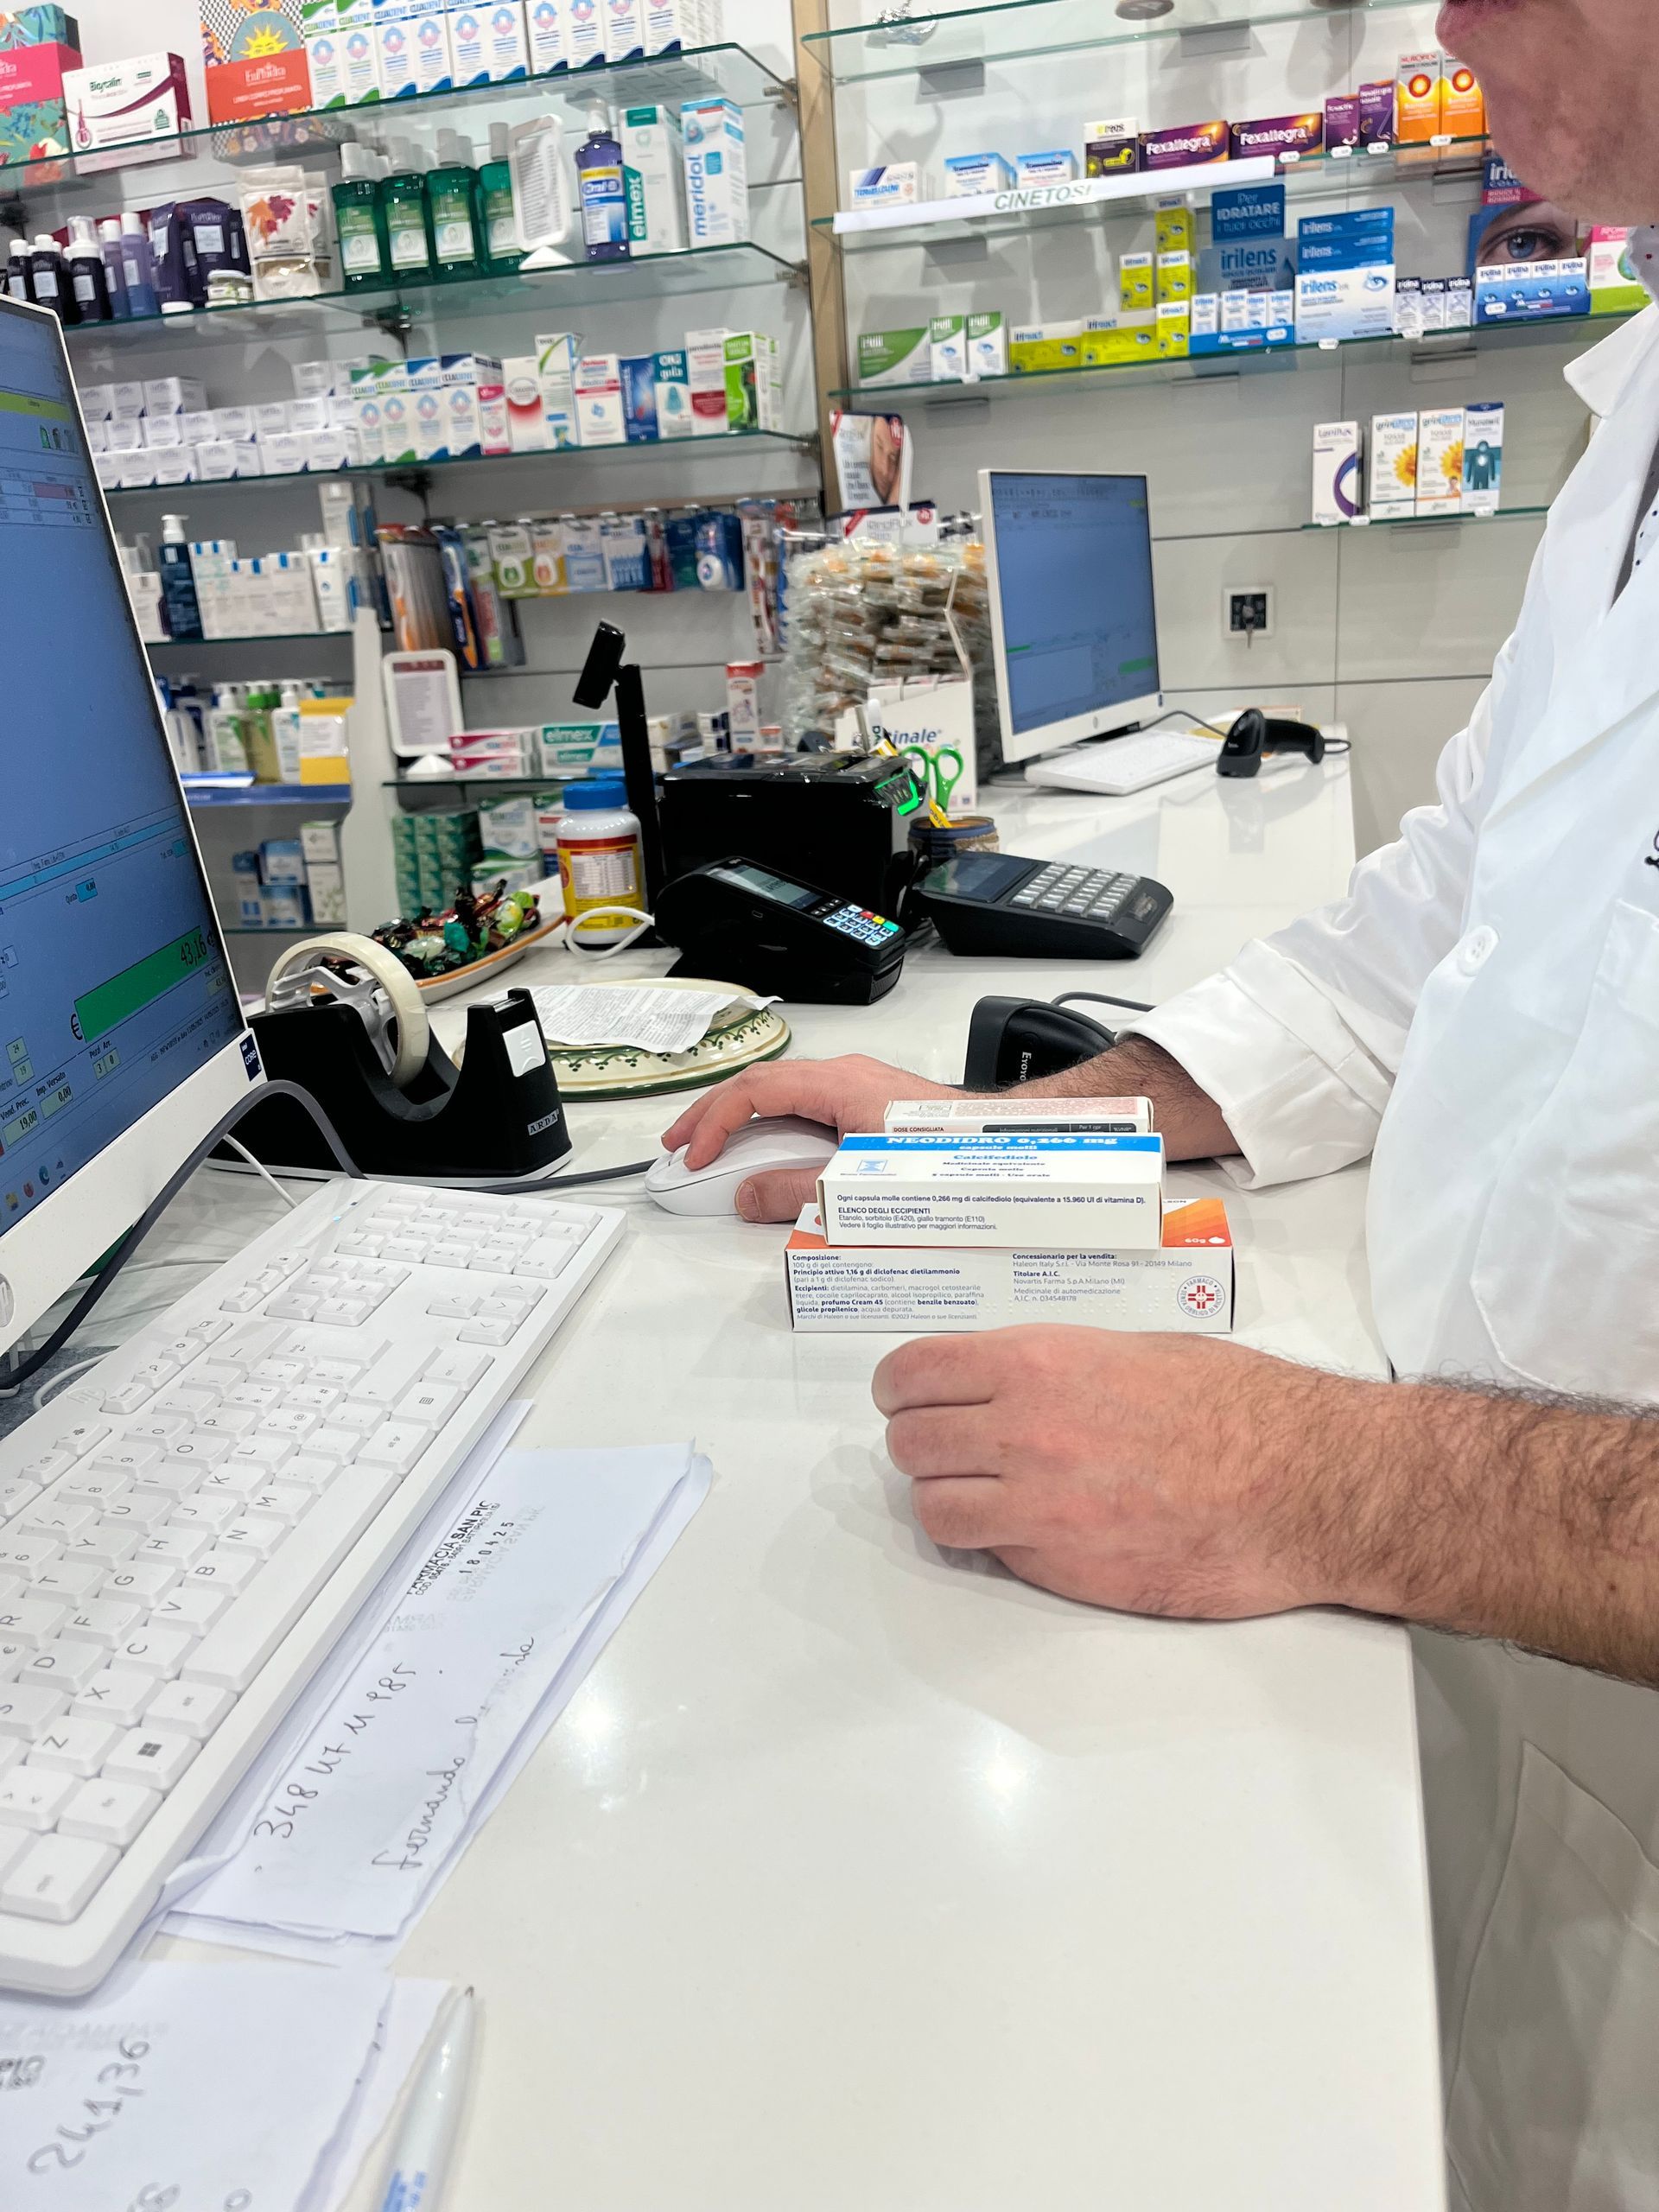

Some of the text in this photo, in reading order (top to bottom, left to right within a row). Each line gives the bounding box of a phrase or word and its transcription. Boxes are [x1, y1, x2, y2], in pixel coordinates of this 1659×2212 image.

[1146, 137, 1211, 156] Fexallegra
[1241, 127, 1306, 147] Fexallegra
[688, 154, 707, 237] meridol
[995, 184, 1091, 210] CINETOSI
[628, 175, 645, 238] elmex
[1217, 202, 1281, 220] IDRATARE
[1221, 247, 1276, 270] irilens
[1300, 280, 1338, 295] irilens
[545, 728, 594, 743] elmex
[181, 933, 207, 967] 43,16
[19, 1110, 37, 1130] 19,00
[1013, 1196, 1055, 1205] (equivalente
[450, 1518, 474, 1540] SAN
